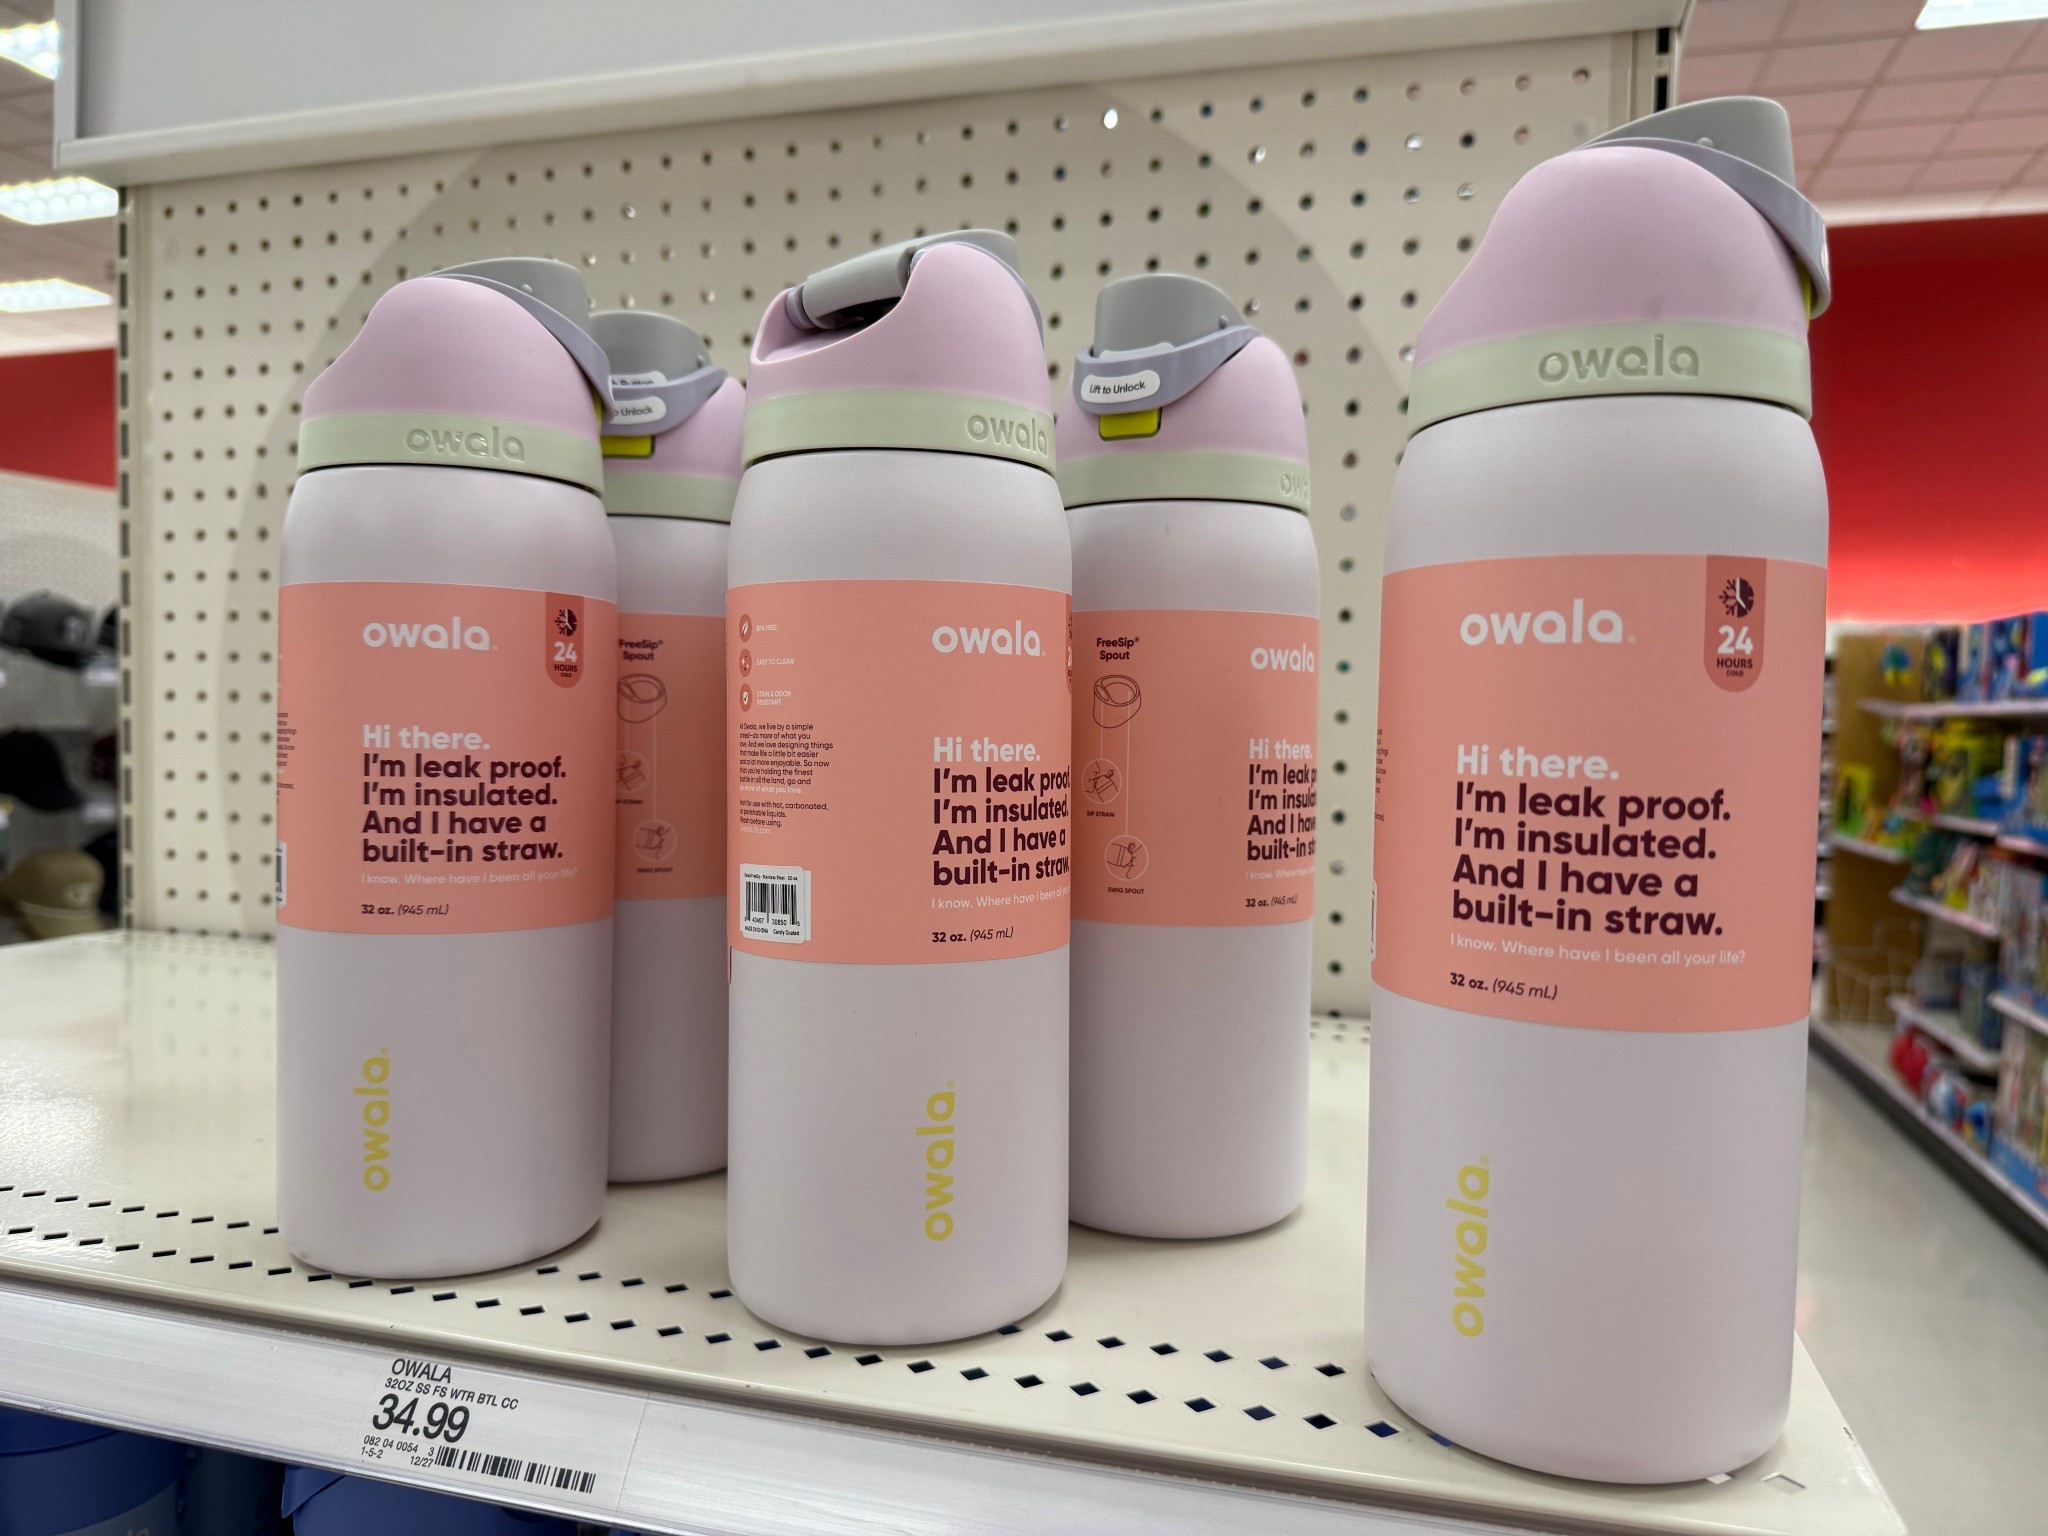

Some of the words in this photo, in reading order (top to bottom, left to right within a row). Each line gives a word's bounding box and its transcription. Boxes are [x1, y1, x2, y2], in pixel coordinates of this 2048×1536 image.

[1538, 334, 1699, 383] owala
[1090, 384, 1101, 394] Lift
[1103, 385, 1111, 394] to
[1113, 381, 1146, 394] Unlock
[621, 406, 654, 416] Unlock
[406, 427, 525, 462] owala
[967, 414, 1048, 457] owala
[363, 616, 490, 651] owala
[1460, 598, 1622, 646] owala
[932, 620, 1040, 656] owala
[1718, 625, 1753, 655] 24
[553, 641, 577, 662] 24
[623, 651, 654, 662] Spout
[1099, 650, 1130, 661] Spout
[1250, 643, 1314, 672] owala
[1716, 657, 1753, 669] HOURS
[554, 664, 577, 672] HOURS
[363, 725, 390, 748] Hi
[399, 726, 490, 750] there.
[791, 723, 813, 731] simple
[778, 741, 809, 750] designing
[810, 742, 833, 750] things
[934, 736, 962, 762] Hi
[971, 737, 1040, 762] there.
[1249, 738, 1269, 759] Hi
[1275, 739, 1312, 759] there.
[364, 753, 406, 777] I'm
[415, 754, 481, 778] leak
[490, 755, 566, 783] proof.
[794, 768, 813, 776] finest
[1249, 764, 1278, 784] I'm
[1283, 763, 1309, 784] leak
[1457, 744, 1489, 775] Hi
[1499, 746, 1619, 780] there.
[934, 768, 976, 793] I'm
[986, 767, 1035, 792] leak
[364, 782, 406, 806] I'm
[415, 783, 557, 806] insulated.
[785, 802, 829, 811] carbonated,
[1248, 789, 1277, 810] I'm
[1456, 781, 1505, 813] I'm
[1519, 782, 1606, 817] leak
[1618, 788, 1731, 827] proof.
[934, 799, 976, 824] I'm
[986, 794, 1069, 822] insulated.
[362, 810, 422, 834] And
[433, 811, 439, 834] I
[450, 811, 522, 834] have
[530, 815, 546, 833] a
[1247, 814, 1285, 835] And
[1290, 813, 1294, 834] I
[363, 839, 473, 862] built-in
[482, 841, 563, 861] straw.
[932, 828, 991, 855] And
[1000, 828, 1005, 852] I
[1014, 827, 1056, 851] have
[1060, 828, 1065, 846] a
[1247, 837, 1306, 860] built-in
[1455, 817, 1504, 850] I'm
[1517, 821, 1716, 860] insulated.
[367, 874, 401, 884] know.
[405, 874, 446, 884] Where
[449, 873, 480, 884] have
[490, 872, 519, 882] been
[522, 871, 536, 881] all
[538, 871, 559, 882] your
[560, 867, 578, 879] life?
[934, 857, 1030, 885] built-in
[1035, 855, 1069, 879] straw.
[1452, 854, 1524, 889] And
[1538, 860, 1546, 891] I
[1560, 861, 1662, 897] have
[1674, 873, 1698, 897] a
[361, 904, 375, 915] 32
[378, 906, 394, 915] oz.
[398, 904, 423, 916] (945
[427, 904, 449, 915] mL)
[938, 898, 973, 909] know.
[976, 896, 1011, 907] Where
[1013, 893, 1035, 905] have
[1040, 889, 1056, 900] been
[1245, 898, 1256, 907] 32
[1453, 889, 1591, 931] built-in
[1604, 906, 1723, 936] straw.
[932, 932, 946, 943] 32
[950, 934, 966, 942] oz.
[970, 928, 993, 942] (945
[996, 926, 1014, 939] mL)
[1450, 933, 1454, 946] I
[1457, 935, 1497, 952] know.
[1501, 940, 1554, 958] Where
[1559, 945, 1600, 961] have
[1614, 949, 1656, 964] been
[1661, 950, 1680, 965] all
[1684, 952, 1716, 967] your
[1719, 949, 1745, 964] life?
[1450, 972, 1465, 987] 32
[1469, 977, 1488, 991] oz.
[1492, 978, 1525, 996] (945
[1528, 984, 1558, 1000] mL)
[354, 1056, 390, 1192] owala
[915, 1091, 955, 1242] owala
[1446, 1164, 1490, 1338] owala
[391, 1357, 451, 1383] OWALA
[385, 1378, 413, 1393] 32OZ
[415, 1383, 431, 1395] SS
[433, 1385, 448, 1398] FS
[450, 1388, 475, 1403] WTR
[477, 1394, 498, 1407] BTL
[501, 1397, 519, 1410] CC
[372, 1393, 470, 1443] 34.99
[361, 1447, 383, 1459] 1-5-2
[410, 1455, 434, 1468] 12/27
[364, 1435, 380, 1446] 082
[382, 1438, 394, 1449] 04
[396, 1440, 418, 1453] 0054
[428, 1446, 435, 1457] 3
